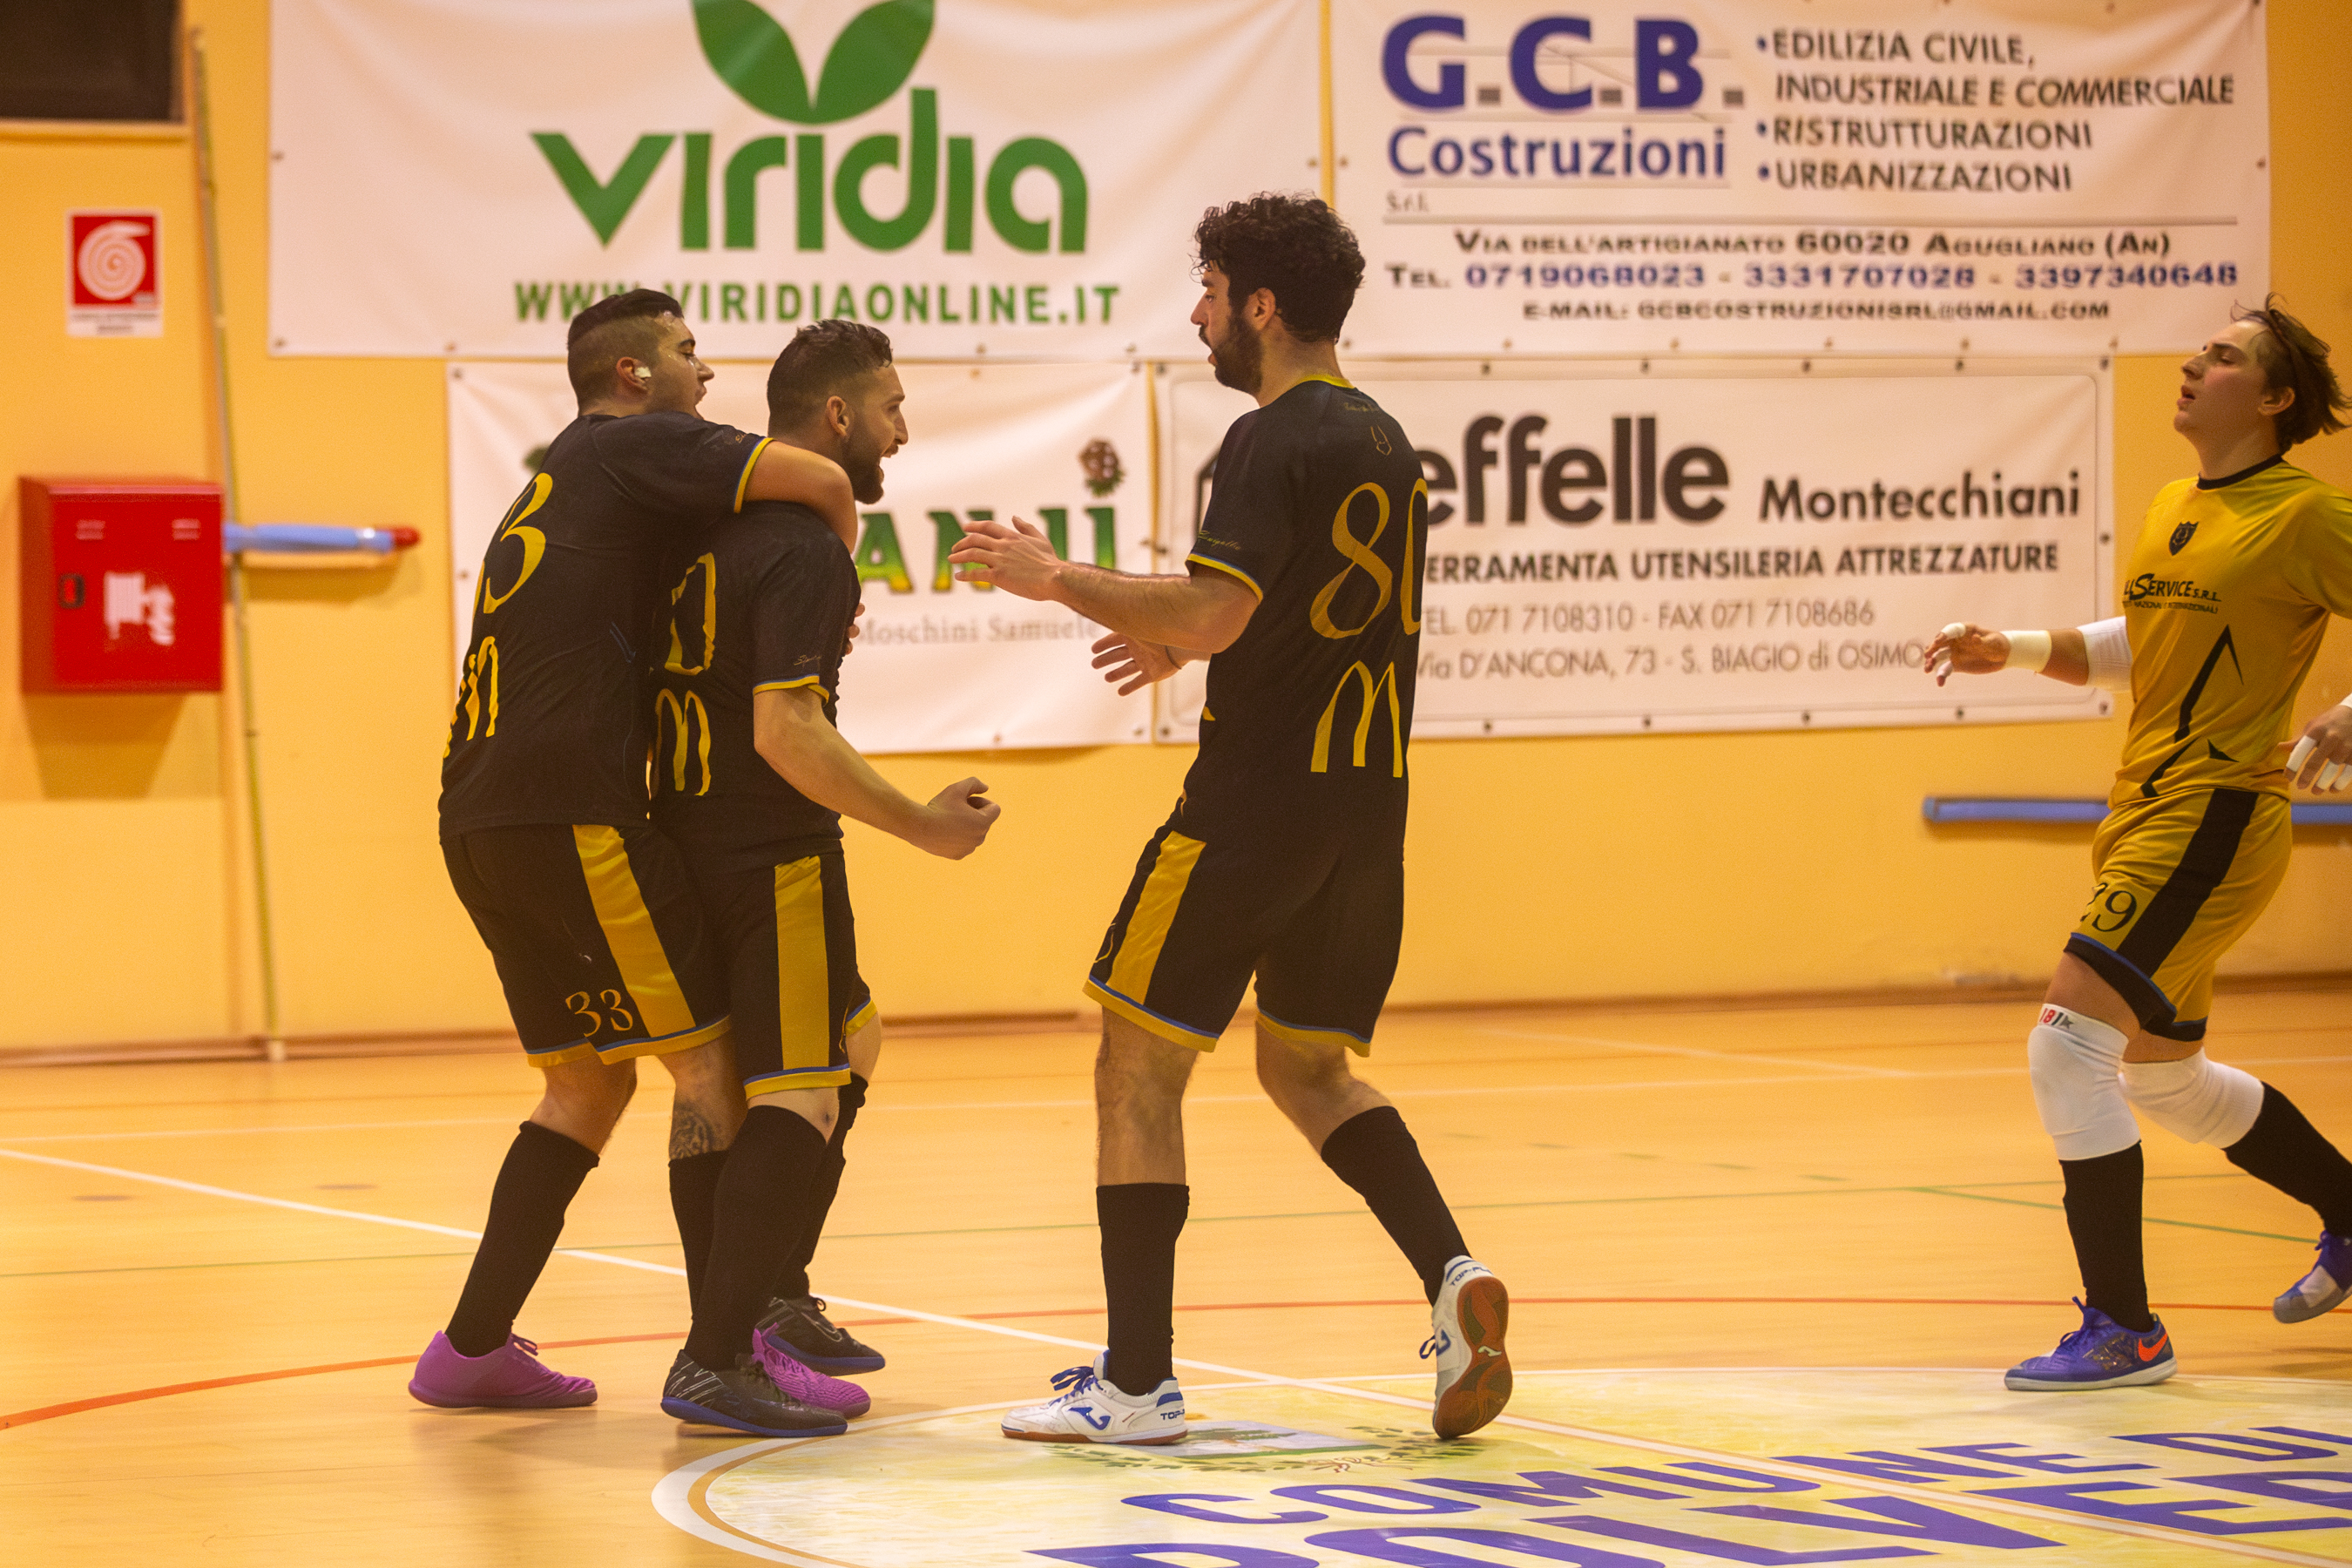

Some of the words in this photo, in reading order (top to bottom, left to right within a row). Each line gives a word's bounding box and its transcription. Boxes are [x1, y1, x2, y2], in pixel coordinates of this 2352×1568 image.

[1382, 13, 1745, 112] G.C.B.
[1774, 29, 1911, 61] EDILIZIA
[1923, 34, 2035, 66] CIVILE,
[1775, 72, 1978, 106] INDUSTRIALE
[1989, 77, 2004, 106] E
[2016, 75, 2235, 107] COMMERCIALE
[1388, 125, 1726, 179] Costruzioni
[1774, 117, 2092, 150] RISTRUTTURAZIONI
[1775, 159, 2072, 193] URBANIZZAZIONI
[1795, 232, 1909, 255] 60020
[1465, 262, 1706, 289] 0719068023
[1744, 262, 1976, 289] 3331707028
[2014, 262, 2239, 289] 3397340648
[1759, 468, 2082, 523] Montecchiani
[1424, 551, 1619, 584] ERRAMENTA
[1631, 548, 1826, 580] UTENSILERIA
[1835, 543, 2059, 576] ATTREZZATURE
[1657, 599, 1704, 631] FAX
[1712, 640, 1802, 674] BIAGIO
[1808, 638, 1831, 672] di
[1837, 637, 1925, 672] OSIMO
[565, 989, 633, 1037] 33
[1120, 1442, 2162, 1524] COMUNE
